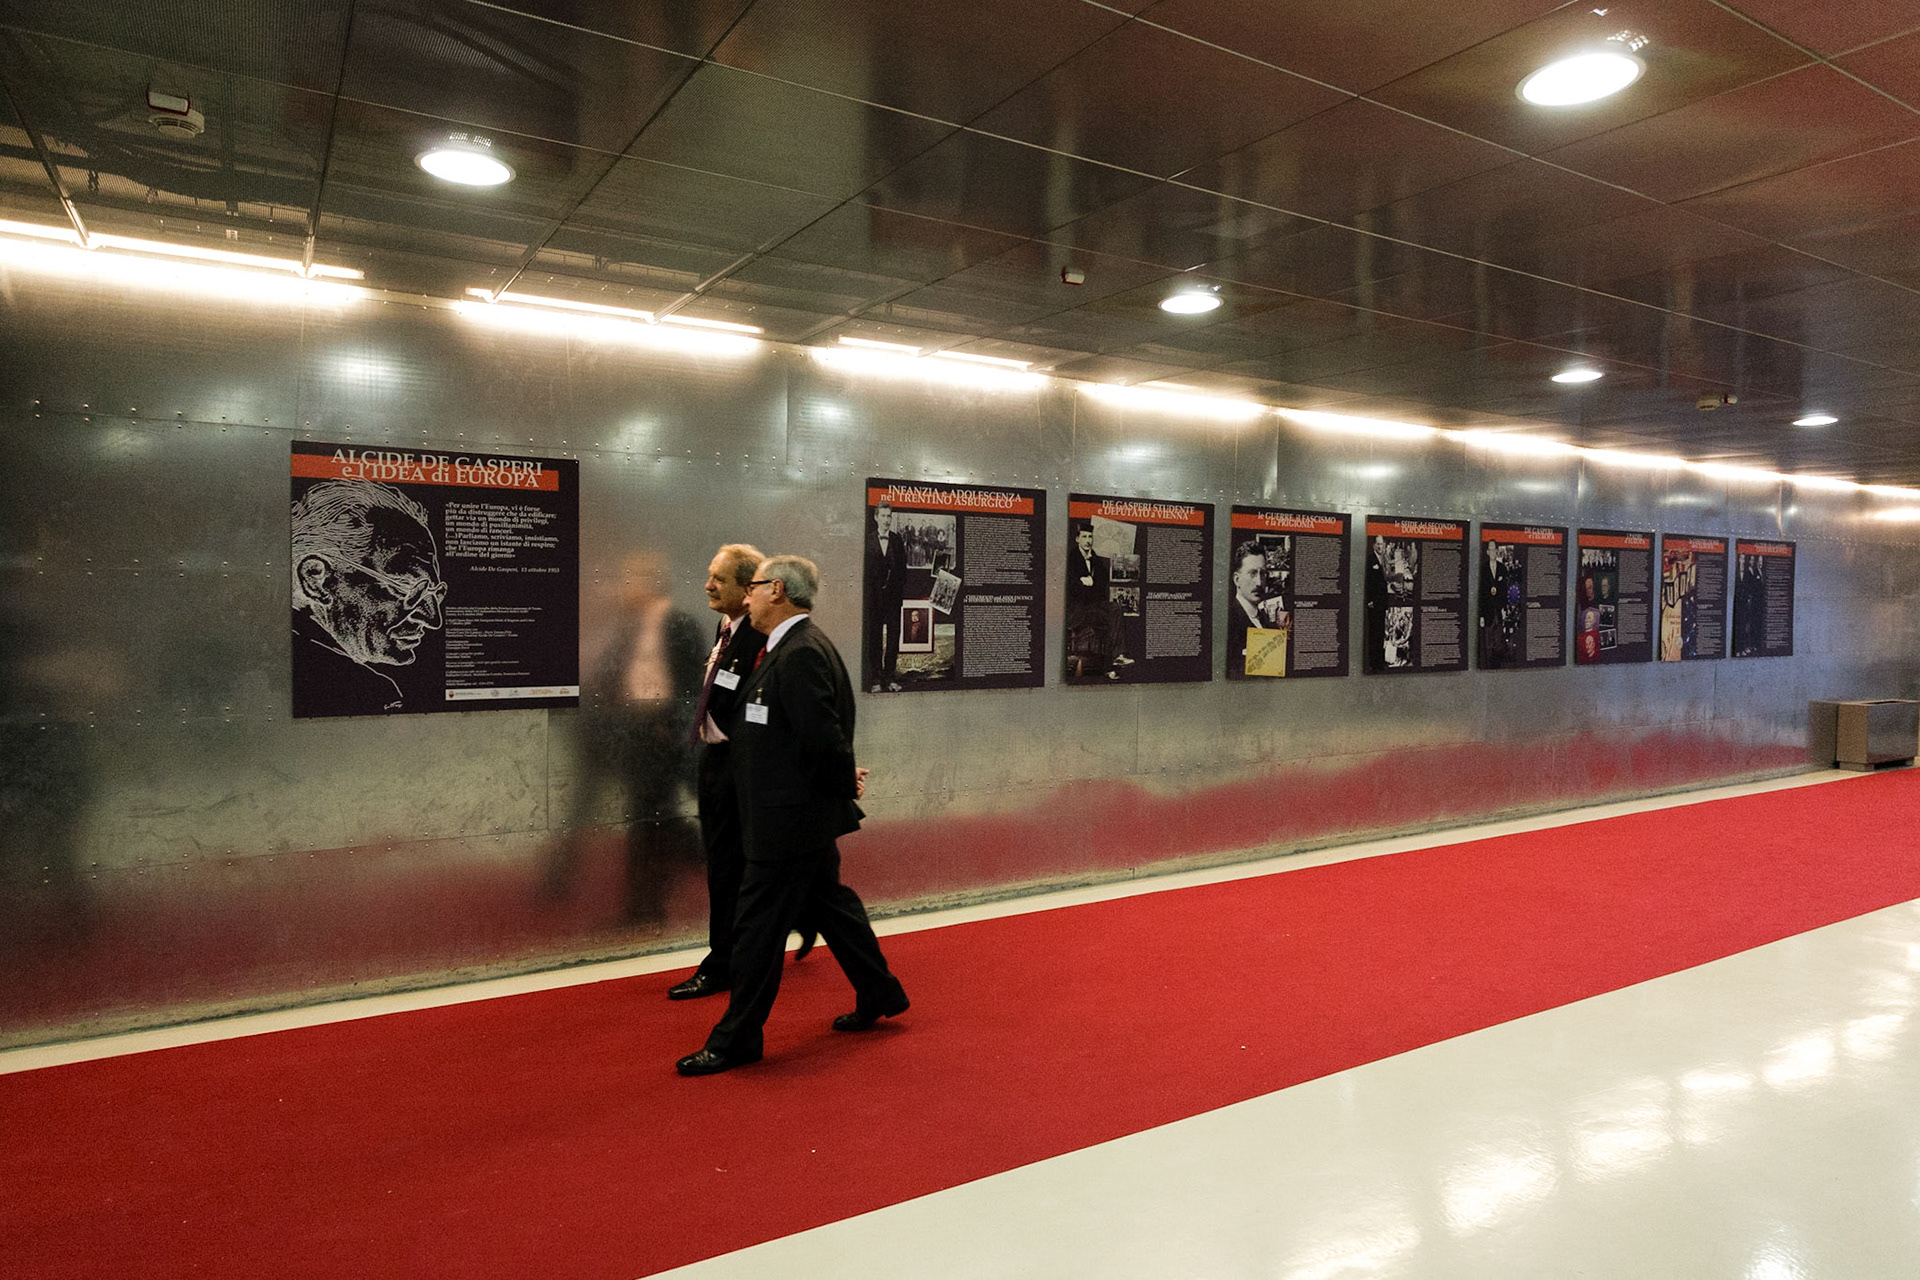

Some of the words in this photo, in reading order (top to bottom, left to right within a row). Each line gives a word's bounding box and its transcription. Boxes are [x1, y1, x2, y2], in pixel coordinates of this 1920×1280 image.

[331, 448, 415, 468] ALCIDE
[421, 454, 450, 471] DE
[455, 457, 543, 476] GASPERI
[342, 466, 352, 477] e
[360, 462, 426, 481] l'IDEA
[431, 468, 450, 482] di
[456, 470, 539, 487] EUROPA
[888, 484, 939, 497] INFANZIA
[951, 489, 1022, 502] ADOLESCENZA
[880, 493, 895, 501] nel
[900, 493, 952, 505] TRENTINO
[954, 498, 1013, 508] ASBURGICO
[1102, 500, 1114, 509] DE
[1115, 501, 1151, 511] GASPERI
[1153, 504, 1195, 514] STUDENTE
[468, 509, 505, 518] distruggere
[1104, 507, 1150, 517] DEPUTATO
[1157, 511, 1188, 520] VIENNA
[1301, 514, 1336, 524] FASCISMO
[1277, 520, 1314, 528] PRIGIONIA
